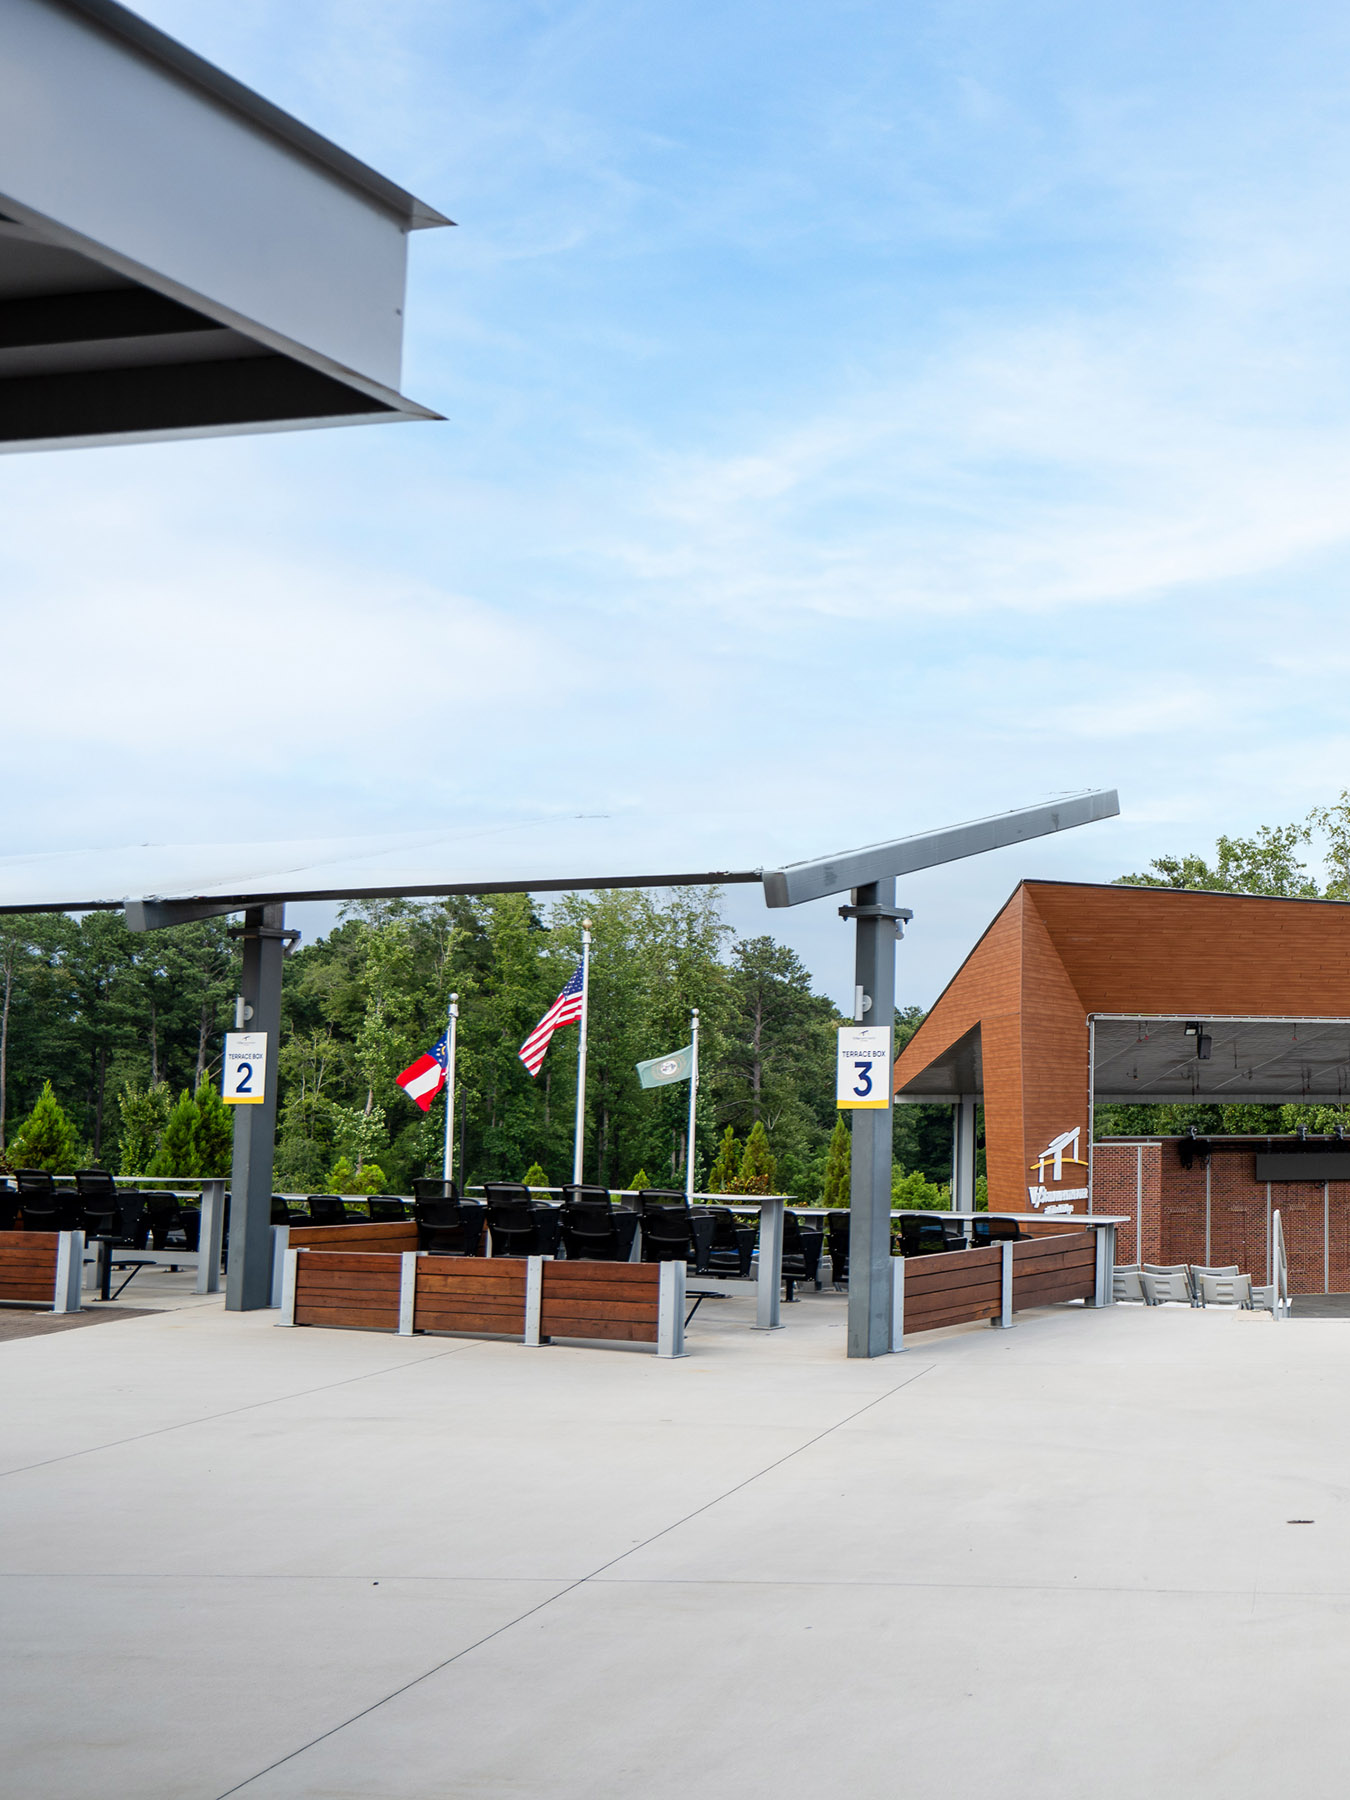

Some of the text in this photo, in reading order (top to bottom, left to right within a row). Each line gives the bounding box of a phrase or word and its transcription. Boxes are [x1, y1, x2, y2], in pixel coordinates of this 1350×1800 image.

[842, 1050, 886, 1058] TERRACE BOX
[235, 1062, 253, 1093] 2
[853, 1061, 873, 1097] 3
